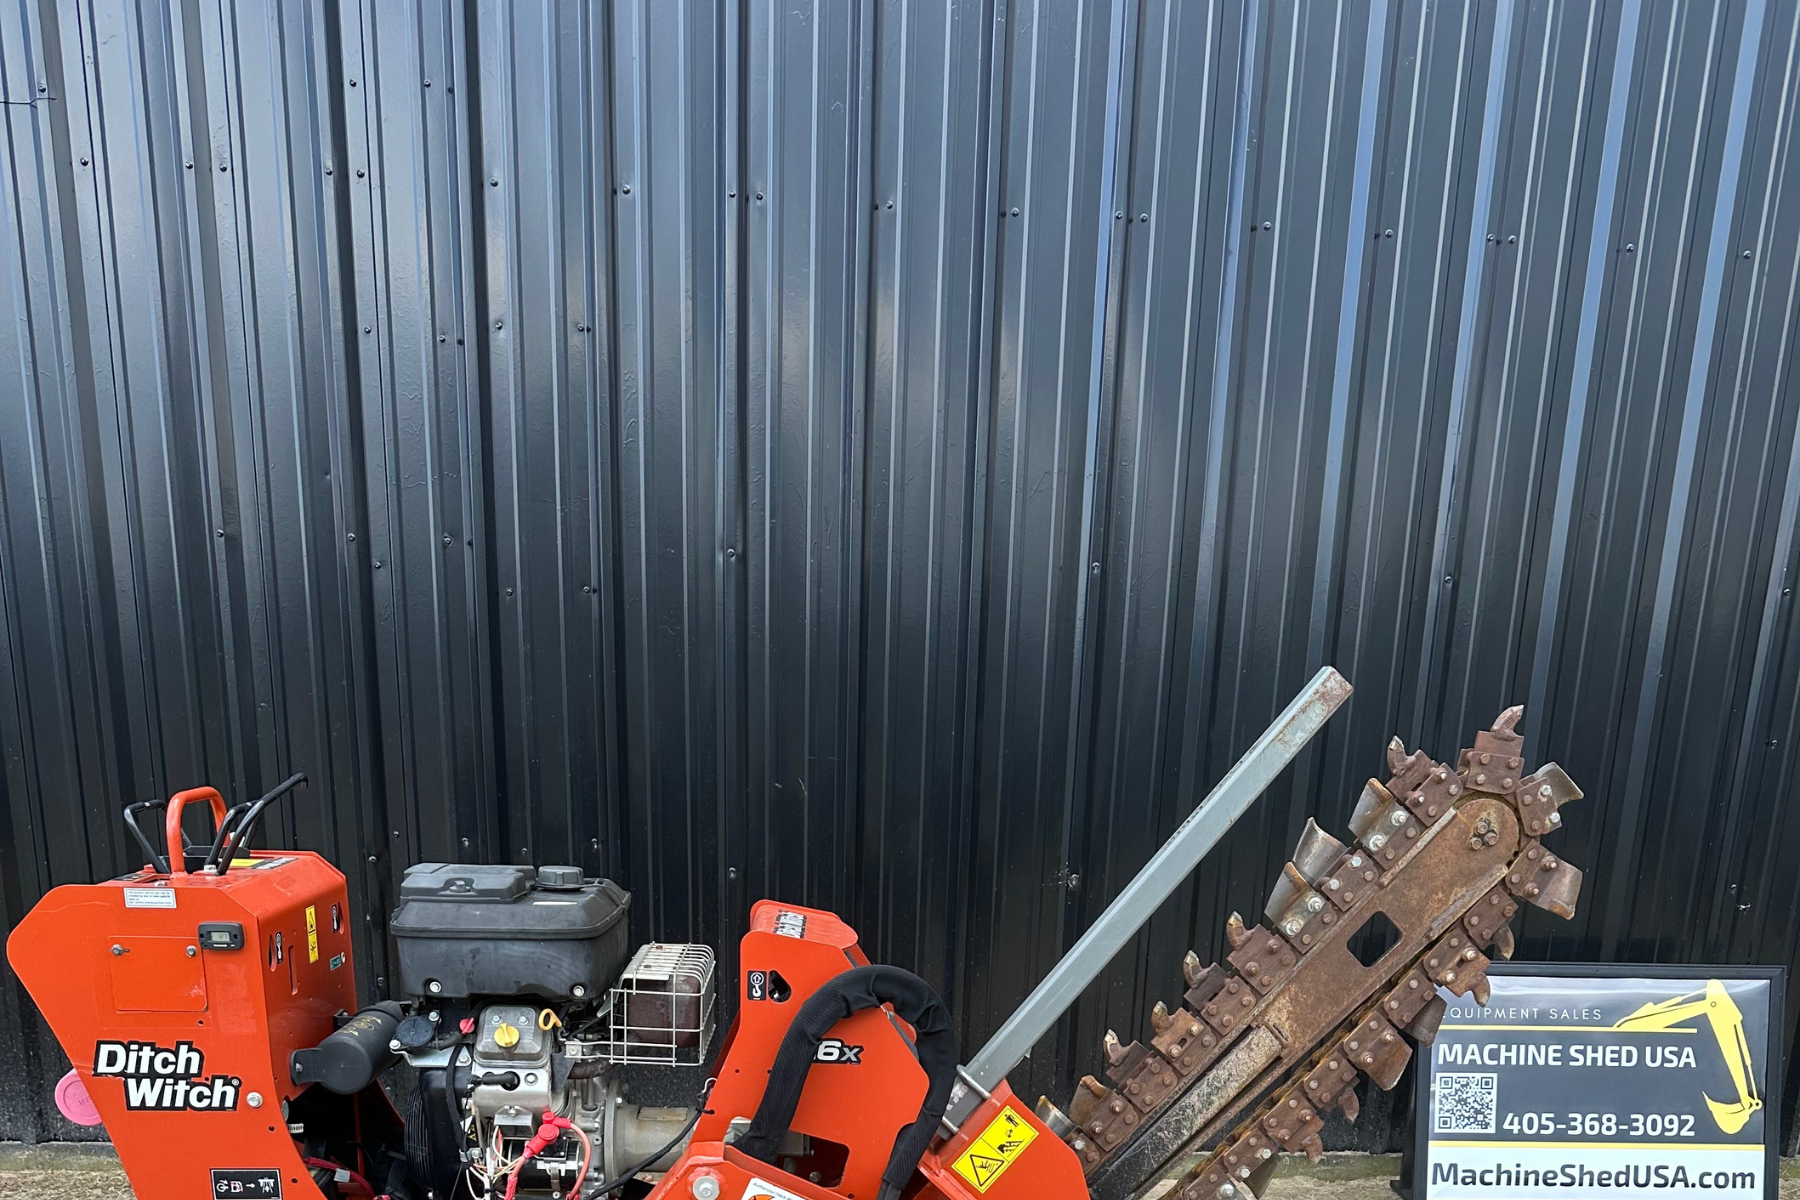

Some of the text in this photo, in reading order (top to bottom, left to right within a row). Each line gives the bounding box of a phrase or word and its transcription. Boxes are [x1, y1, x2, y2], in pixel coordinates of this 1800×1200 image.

[1443, 1007, 1602, 1020] QUIPMENT SALES
[97, 1044, 201, 1075] Ditch
[1437, 1043, 1697, 1068] MACHINE SHED USA
[1501, 1111, 1696, 1137] 405-368-3092
[1431, 1162, 1756, 1190] MachineShedUSA.com
